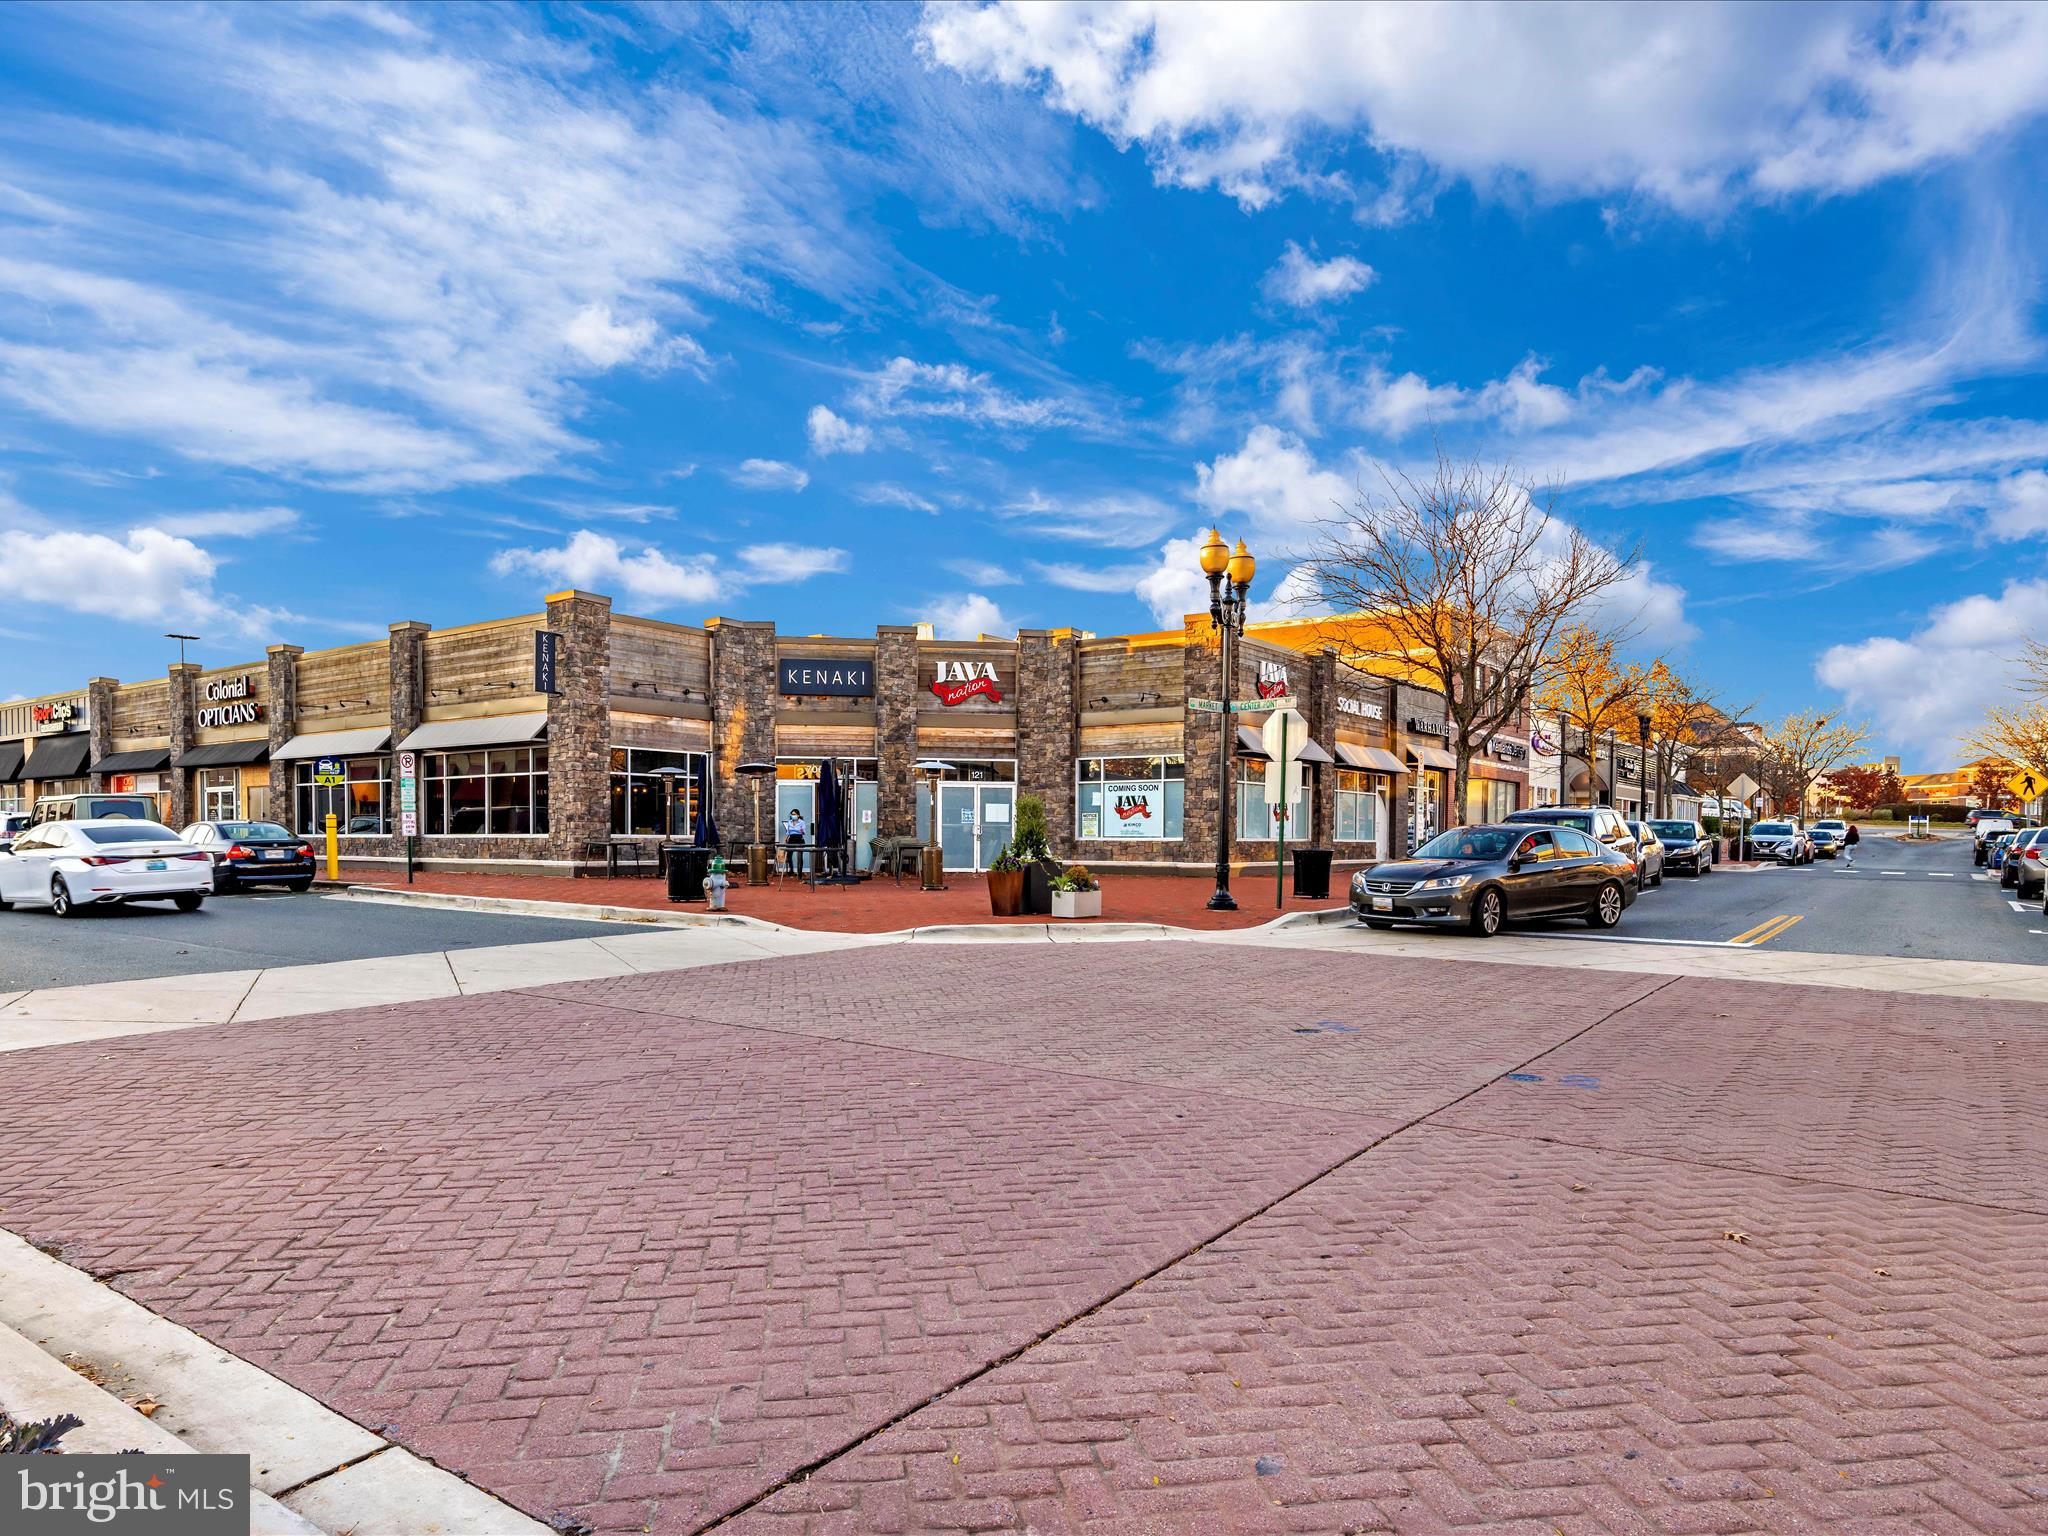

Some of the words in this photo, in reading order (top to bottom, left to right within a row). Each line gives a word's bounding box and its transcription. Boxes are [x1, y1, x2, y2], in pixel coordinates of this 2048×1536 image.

[542, 633, 550, 690] KENAKI
[788, 669, 865, 686] KENAKI
[935, 661, 1000, 683] JAVA
[1259, 660, 1288, 687] JAVA
[206, 675, 247, 701] Colonial
[947, 680, 988, 702] nation
[198, 702, 256, 728] OPTICIANS
[1198, 701, 1218, 711] MARKET
[1240, 702, 1261, 711] CENTER
[1337, 696, 1361, 715] SOCIAL
[1361, 702, 1383, 720] HOUSE
[324, 776, 336, 784] A1
[971, 771, 984, 779] 121
[1138, 784, 1159, 792] SOON
[1116, 795, 1149, 807] JAVA
